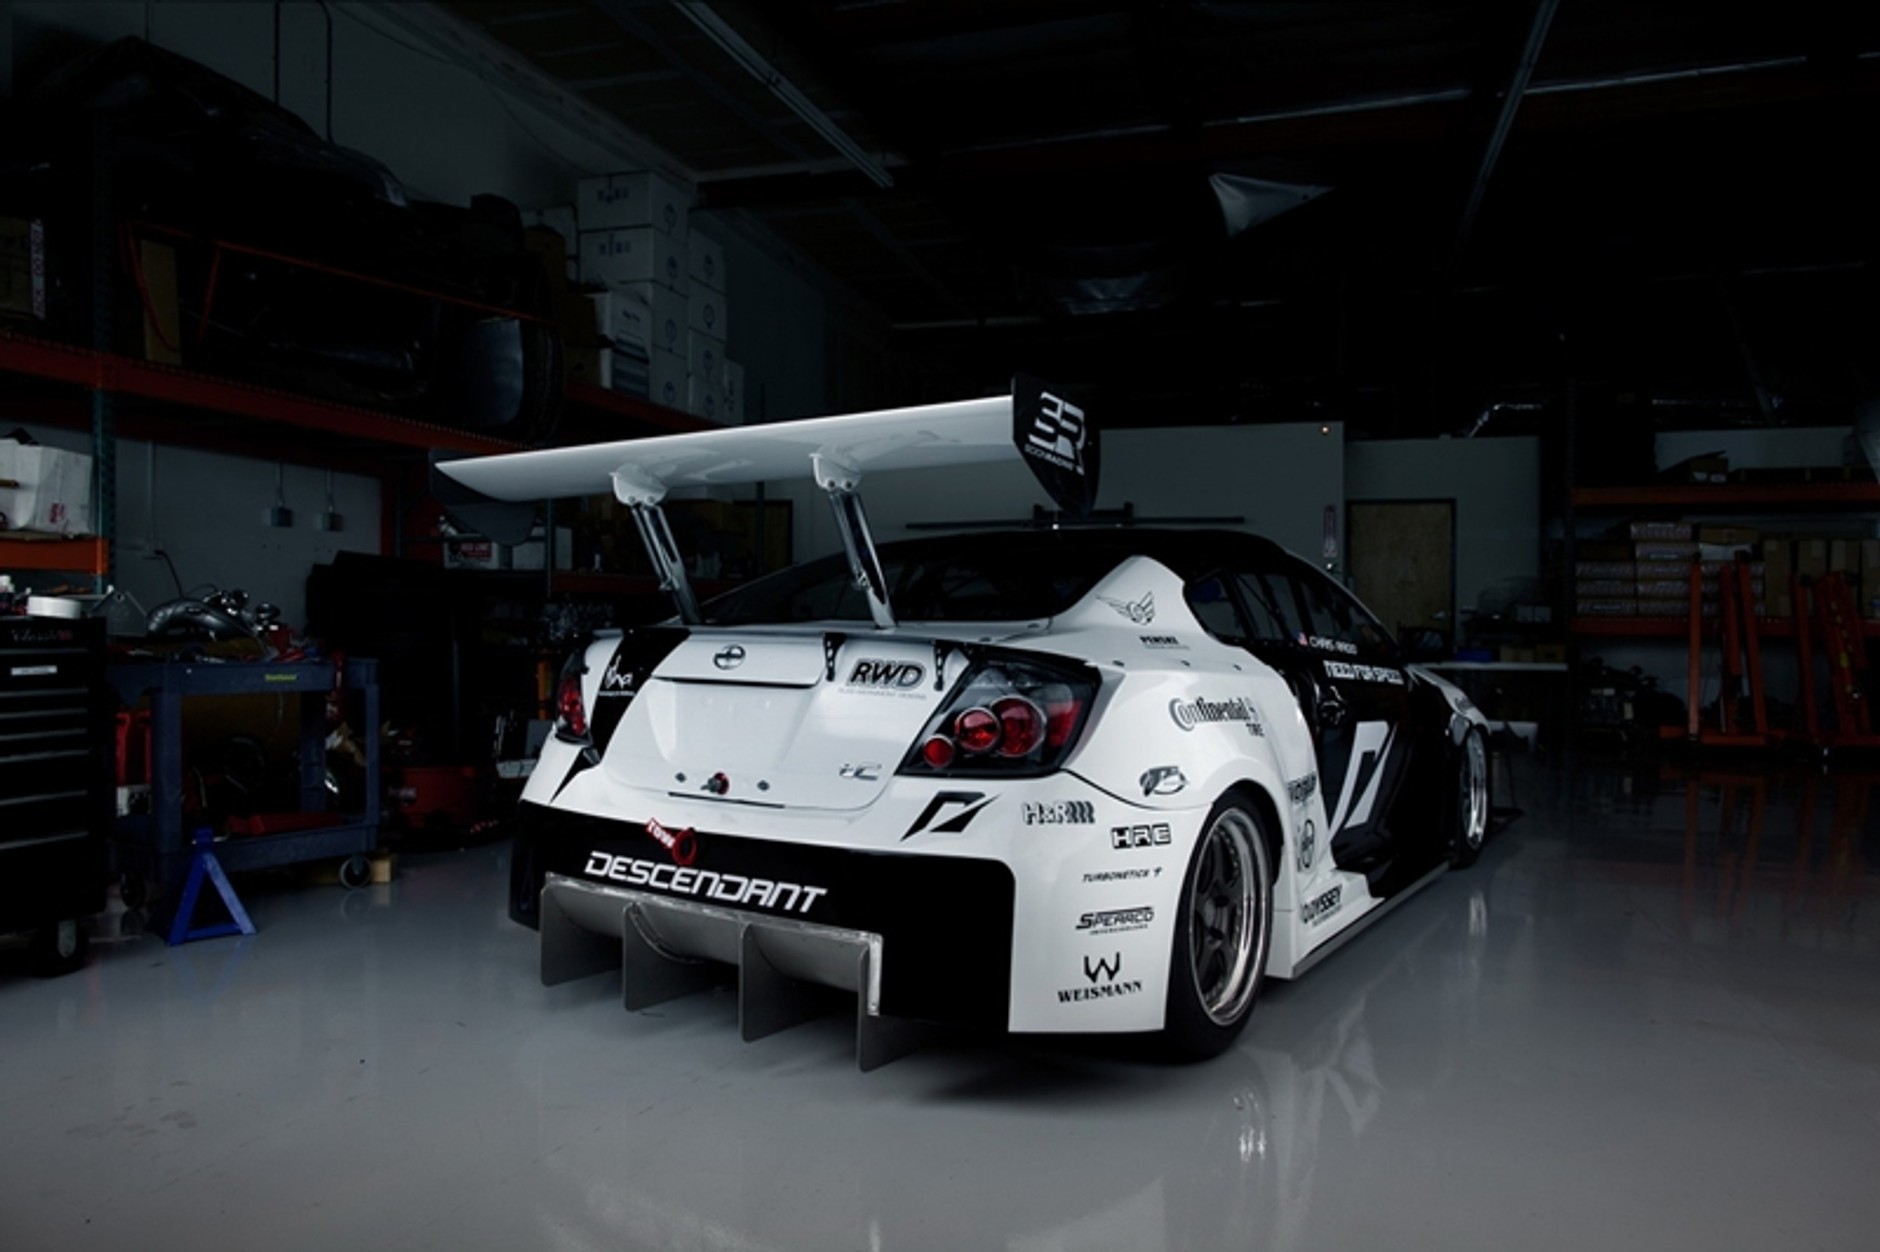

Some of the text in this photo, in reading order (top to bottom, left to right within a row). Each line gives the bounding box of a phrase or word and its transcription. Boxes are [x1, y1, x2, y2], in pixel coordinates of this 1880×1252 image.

[849, 660, 924, 687] RWD
[1168, 696, 1253, 732] Continental
[1111, 822, 1171, 849] HRE
[584, 851, 827, 913] DESCENDANT
[1057, 980, 1142, 1003] WEISMANN
